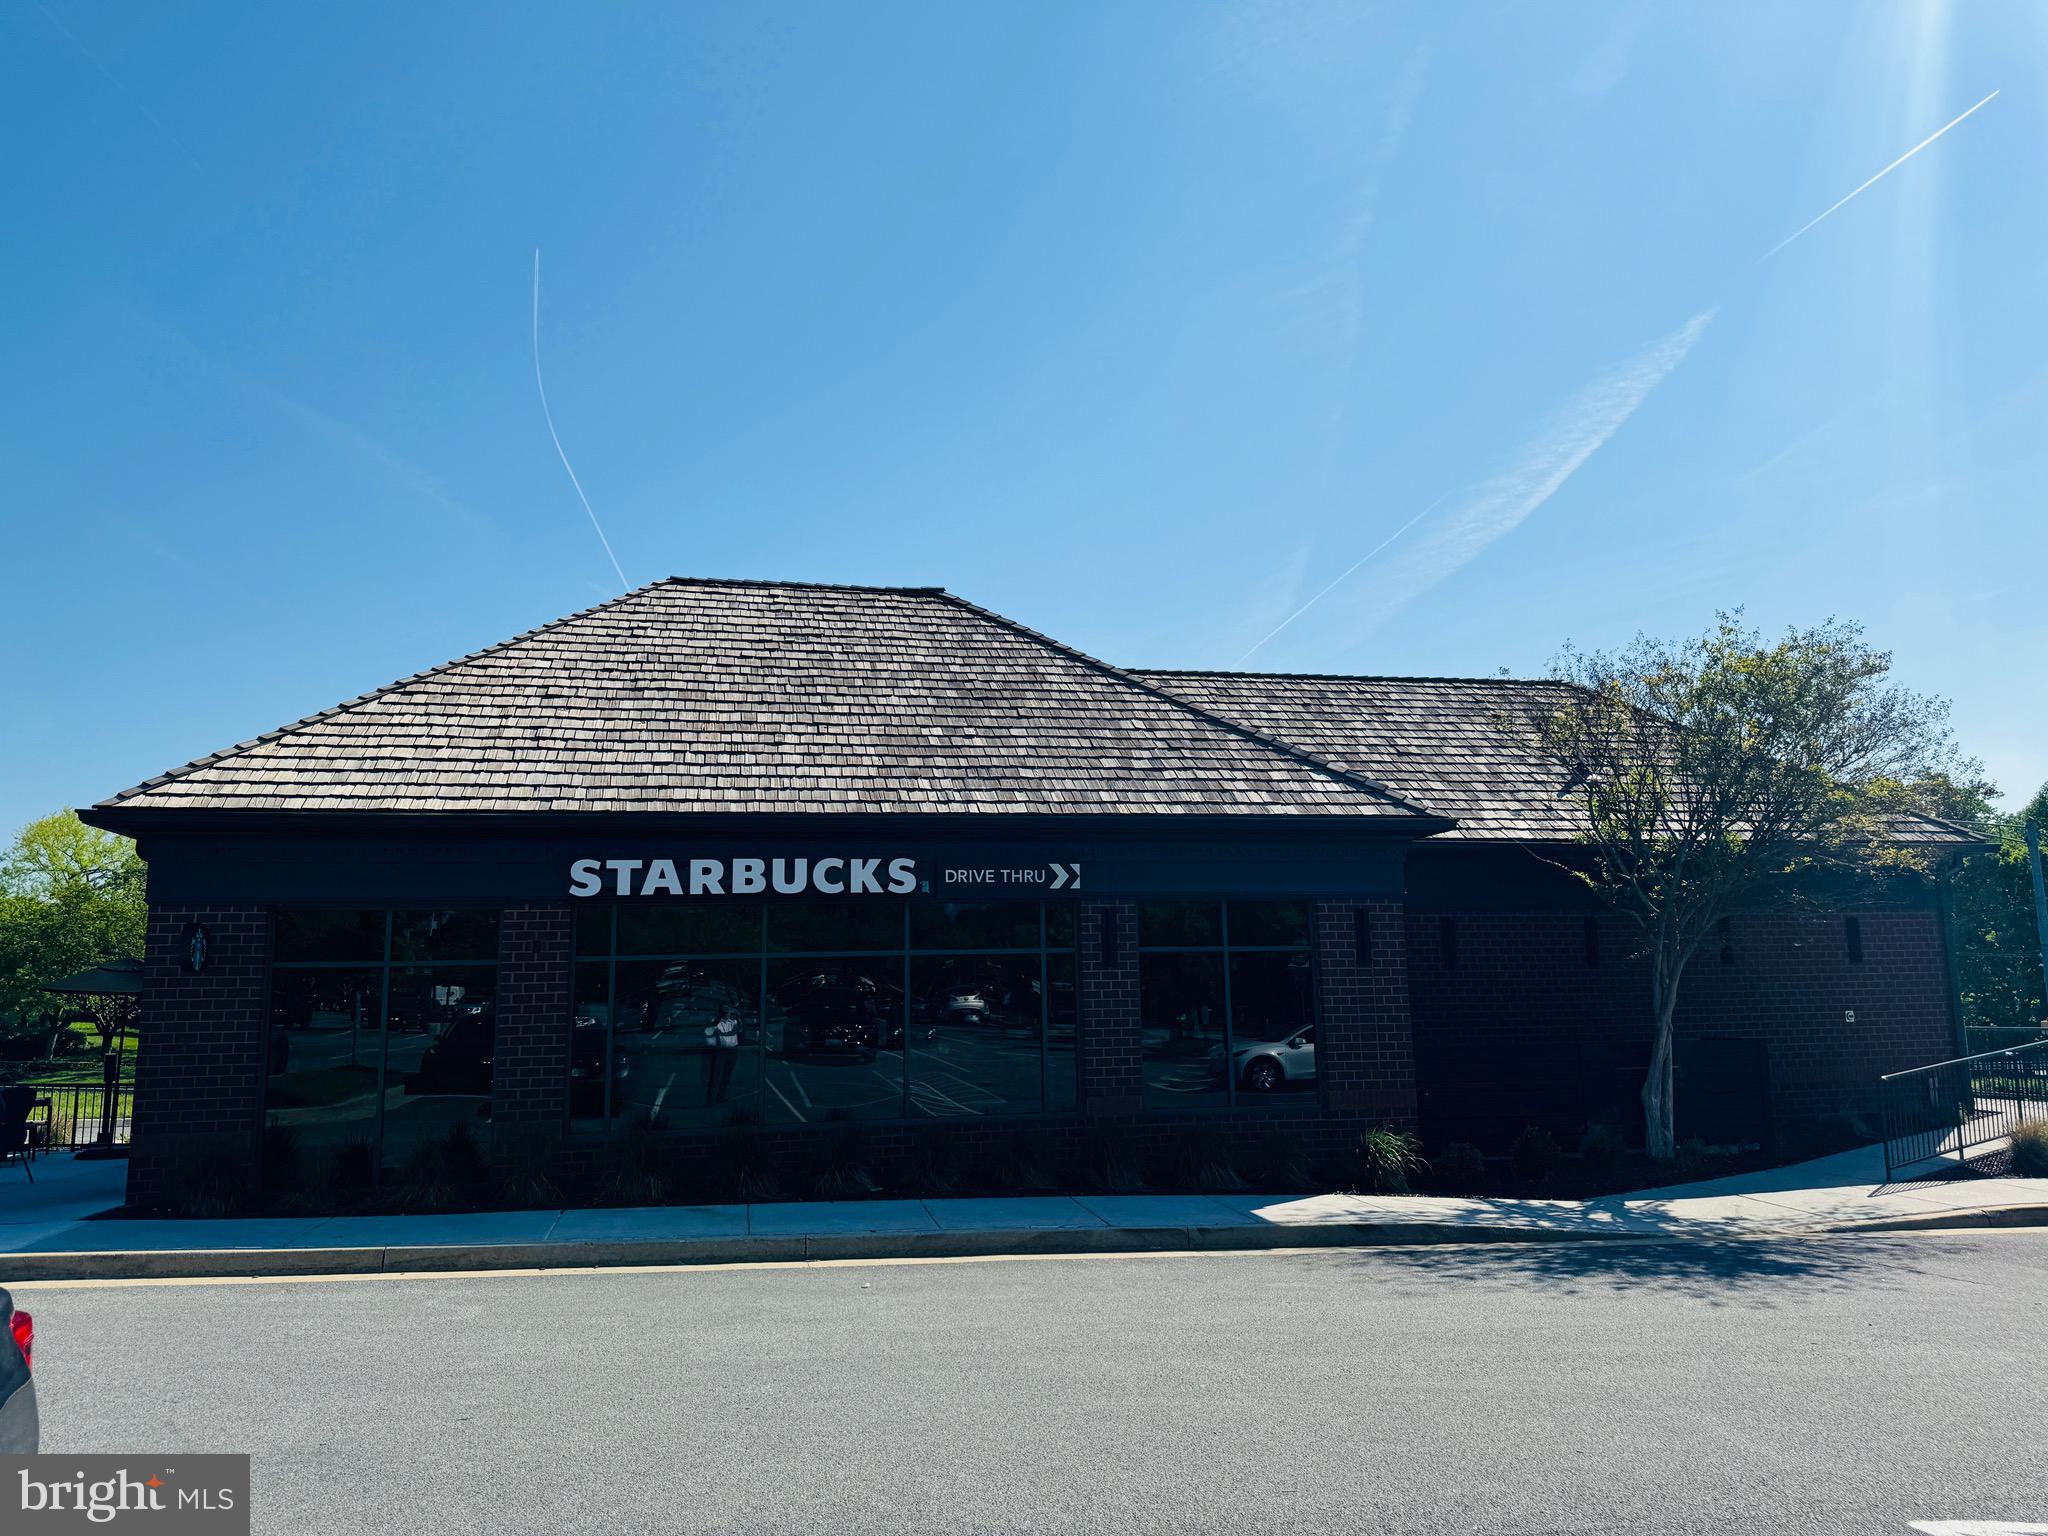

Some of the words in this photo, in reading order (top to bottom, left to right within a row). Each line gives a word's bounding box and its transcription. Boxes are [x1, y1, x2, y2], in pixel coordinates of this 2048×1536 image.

[569, 858, 917, 897] STARBUCKS
[944, 868, 995, 884] DRIVE
[999, 868, 1045, 884] THRU
